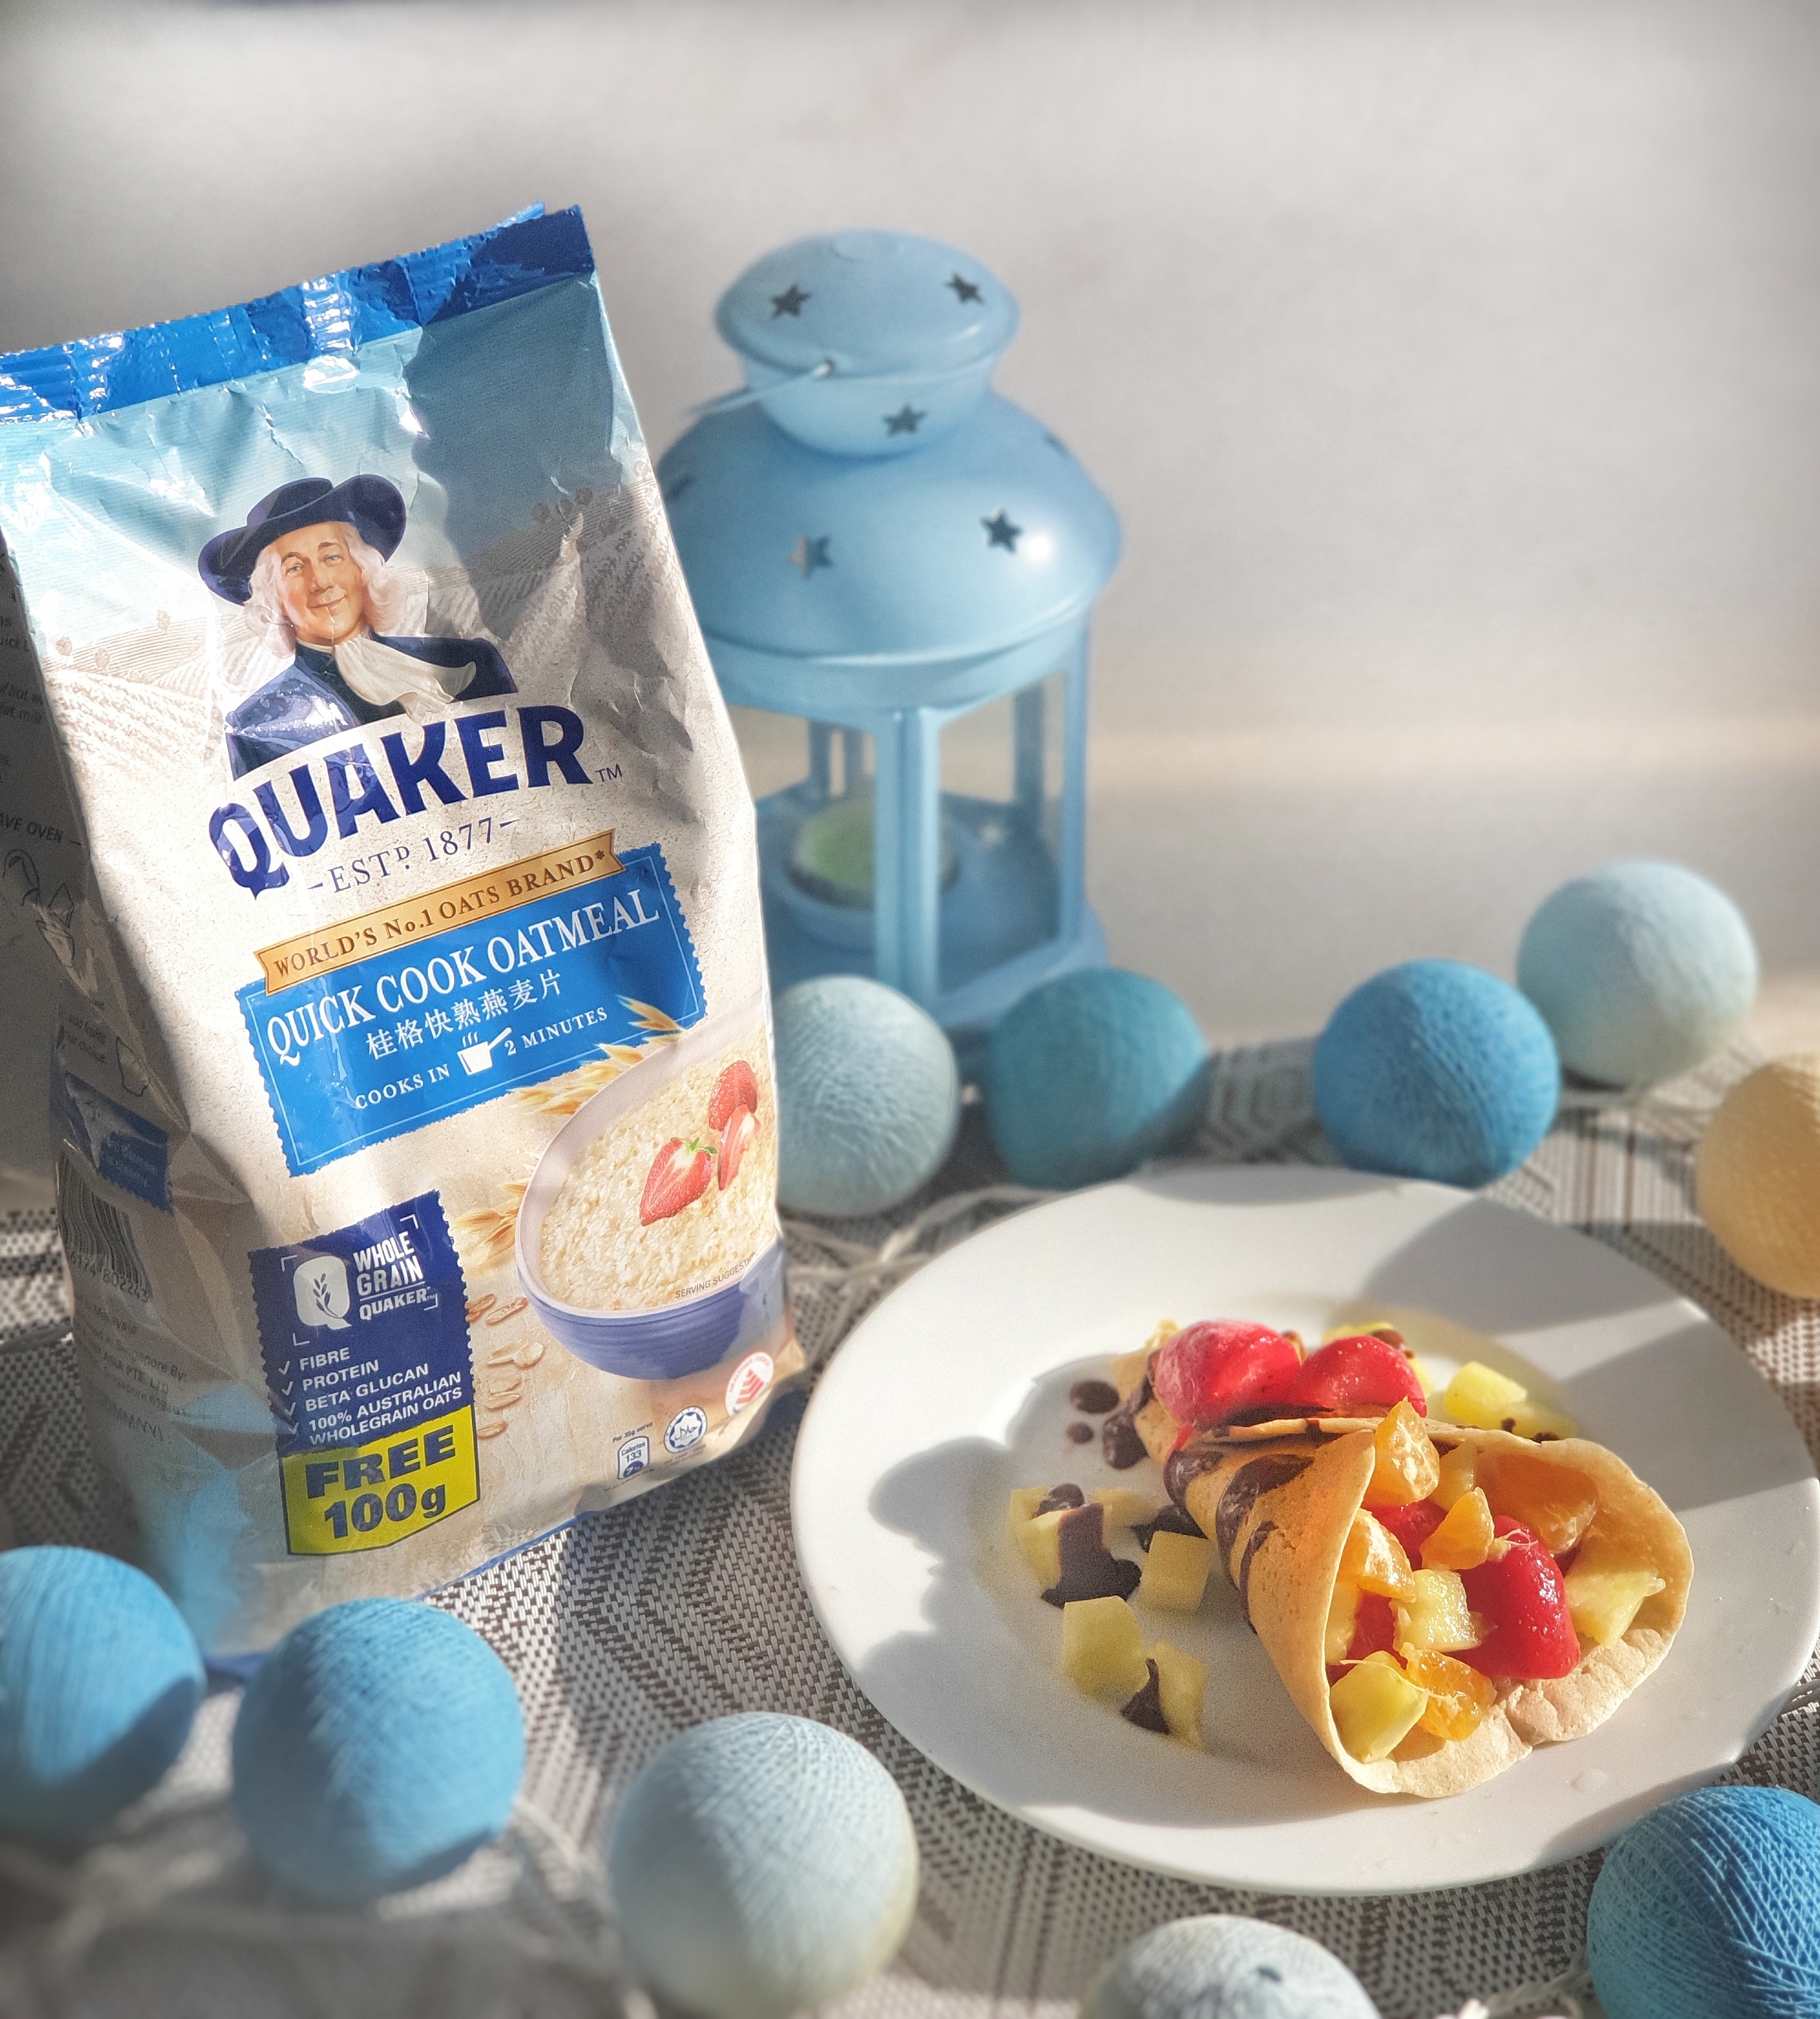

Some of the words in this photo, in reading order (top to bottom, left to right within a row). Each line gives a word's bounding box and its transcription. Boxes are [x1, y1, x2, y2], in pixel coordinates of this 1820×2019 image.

[596, 763, 622, 783] TM
[209, 705, 593, 900] QUAKER
[26, 821, 63, 844] OVEN
[273, 928, 378, 978] WORLD'S
[386, 909, 433, 939] No.1
[439, 886, 501, 922] OATS
[267, 985, 376, 1067] QUICK
[376, 945, 487, 1013] COOK
[487, 889, 660, 973] OATMEAL
[365, 969, 562, 1062] 桂格快熟燕麦片
[504, 1039, 516, 1057] 2
[523, 1006, 608, 1049] MINUTES
[356, 1076, 424, 1109] COOKS
[426, 1063, 451, 1084] IN
[353, 1231, 415, 1272] WHOLE
[356, 1255, 424, 1296] GRAIN
[675, 1279, 711, 1299] SERVING
[359, 1287, 427, 1320] QUAKER
[299, 1347, 351, 1372] FIBRE
[302, 1359, 380, 1391] PROTEIN
[305, 1391, 350, 1412] BETA
[355, 1362, 430, 1399] GLUCAN
[309, 1410, 353, 1432] 100%
[356, 1371, 462, 1421] AUSTRALIAN
[309, 1402, 420, 1445] WHOLEGRAIN
[422, 1387, 463, 1411] OATS
[305, 1425, 456, 1498] FREE
[621, 1441, 646, 1456] Calories
[625, 1450, 642, 1463] 133
[324, 1483, 447, 1539] 100g
